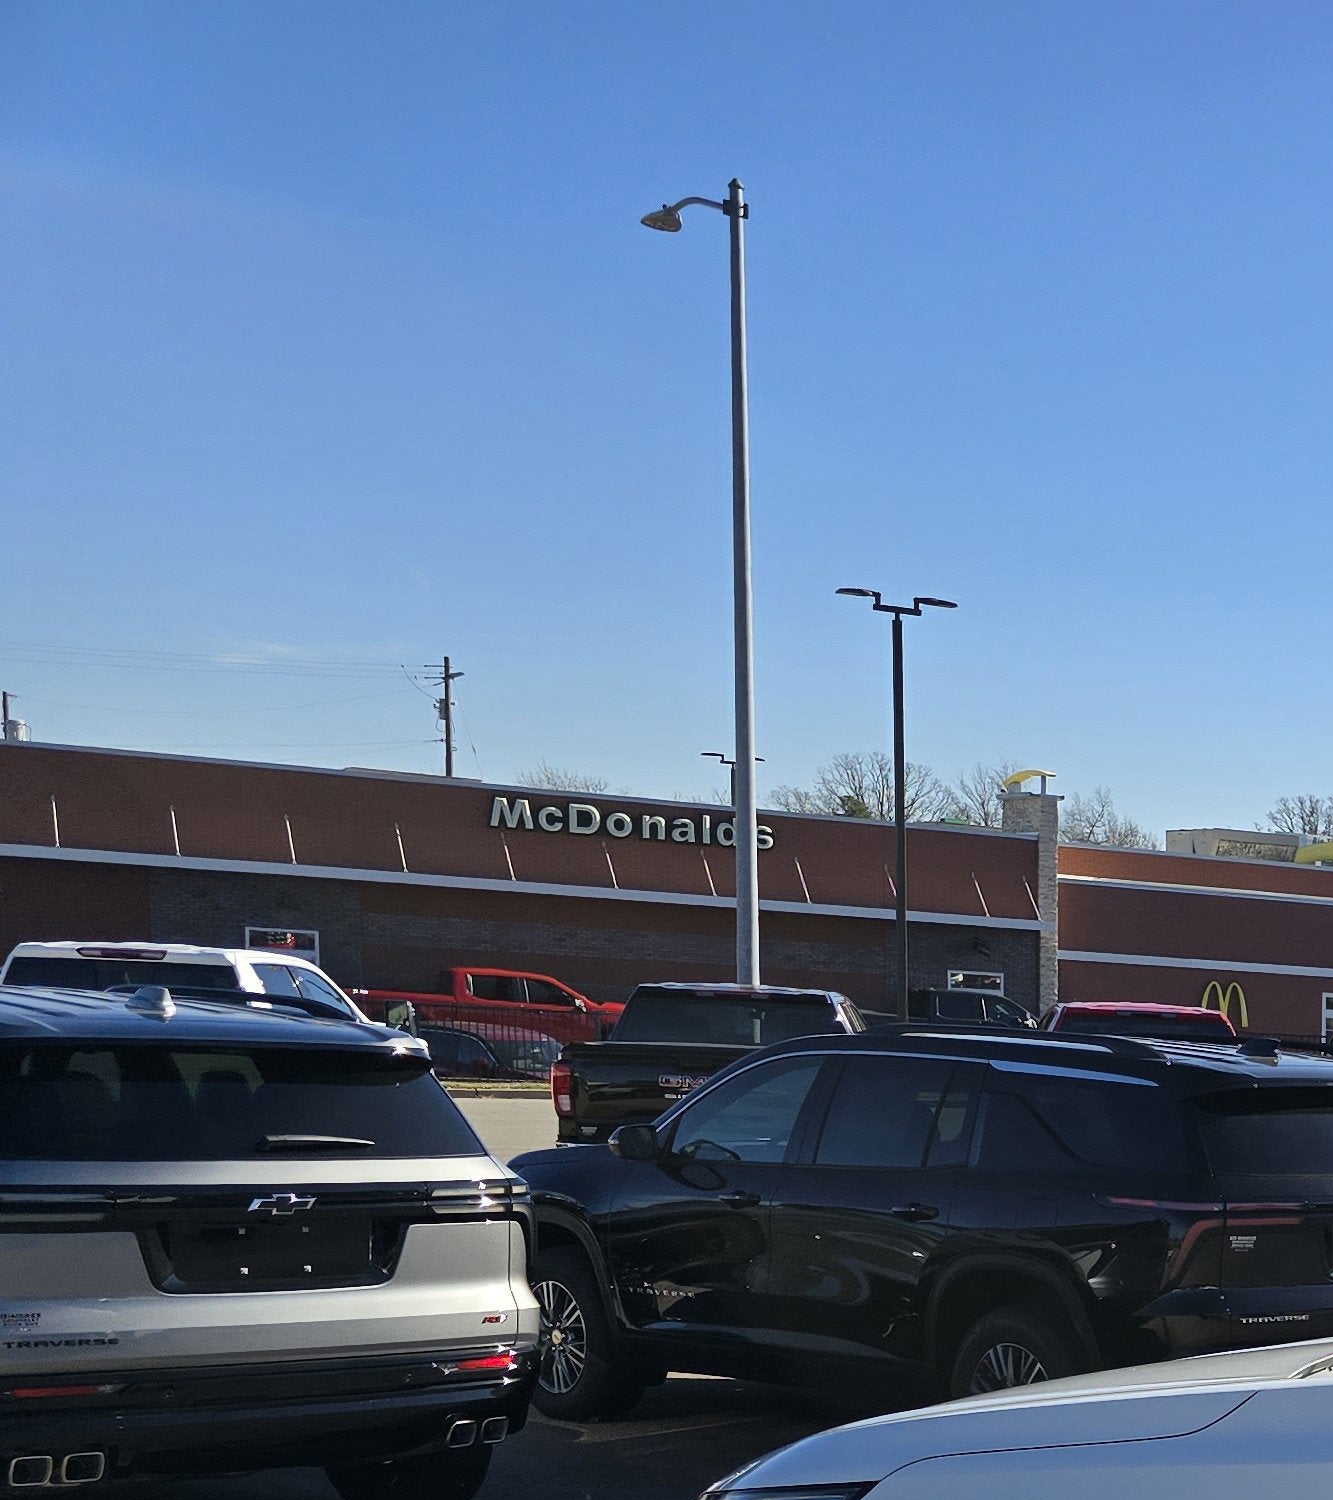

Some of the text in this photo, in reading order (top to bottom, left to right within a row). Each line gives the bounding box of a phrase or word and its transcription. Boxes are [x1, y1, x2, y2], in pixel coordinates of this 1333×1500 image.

[490, 797, 774, 850] McDonalds
[658, 1074, 713, 1088] GM
[1239, 1314, 1310, 1324] TRAVERSE
[2, 1337, 119, 1349] TRAVERSE
